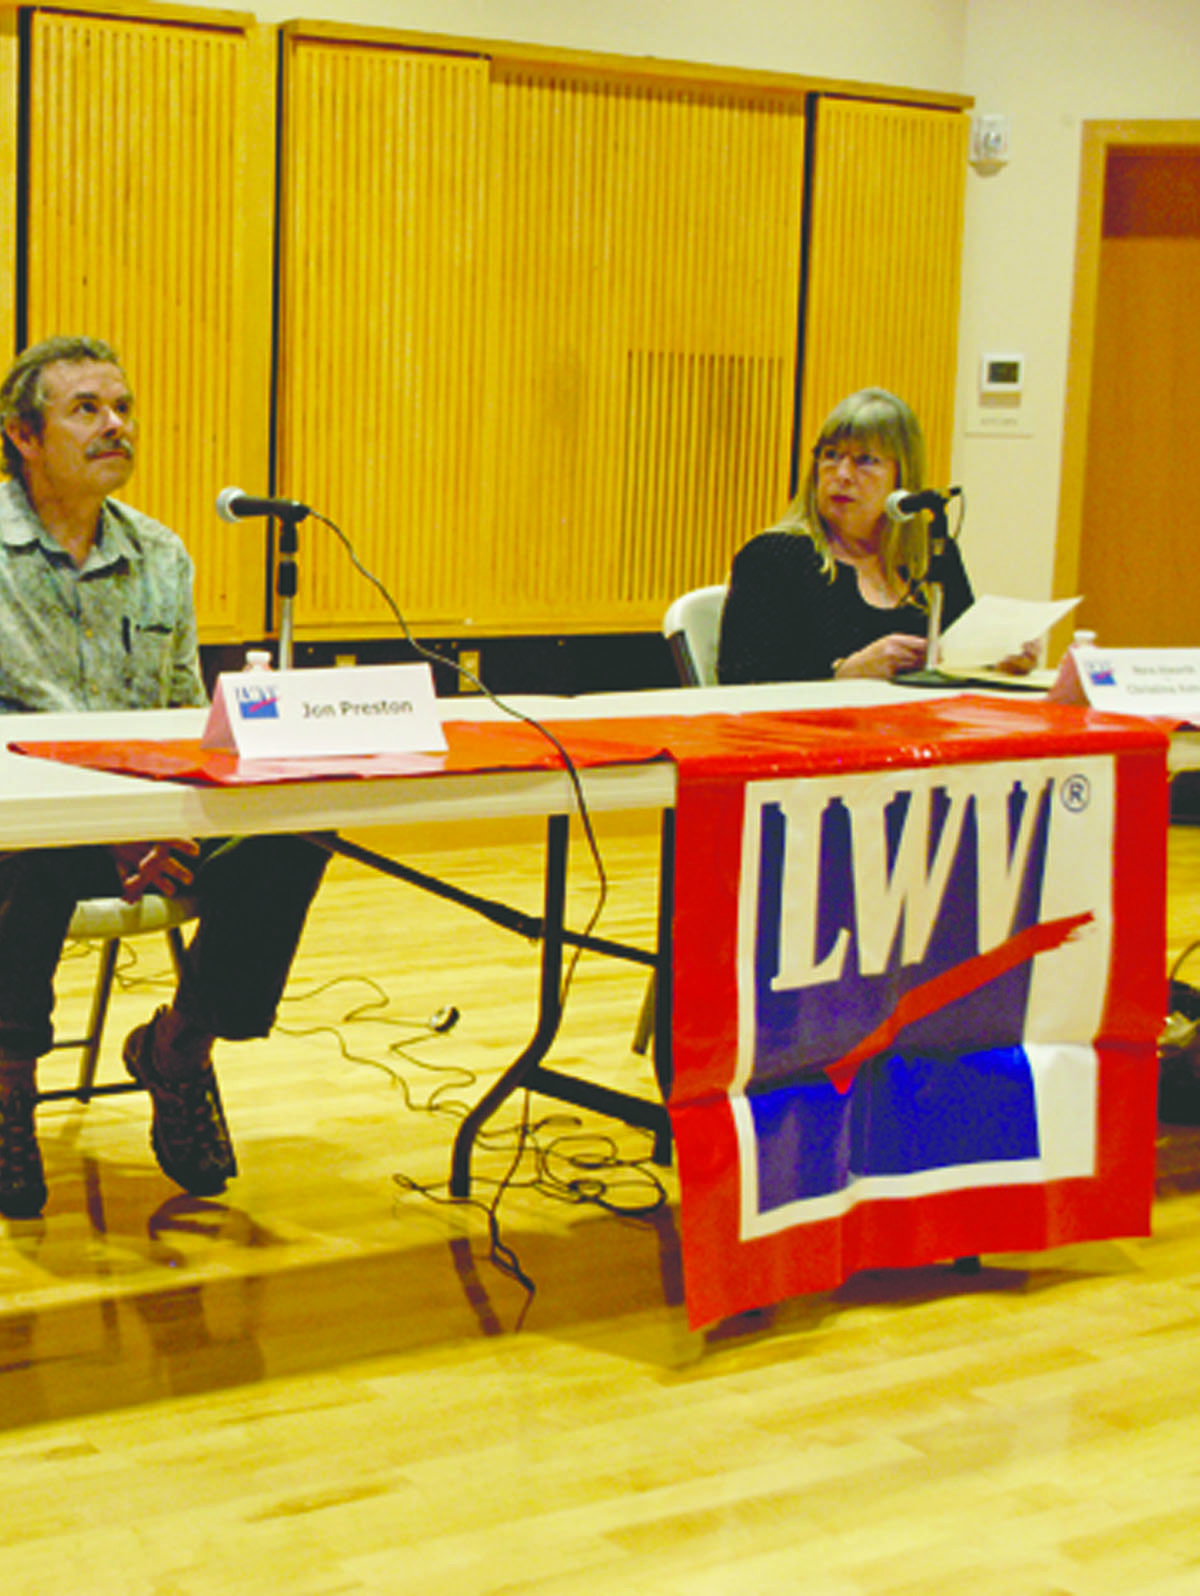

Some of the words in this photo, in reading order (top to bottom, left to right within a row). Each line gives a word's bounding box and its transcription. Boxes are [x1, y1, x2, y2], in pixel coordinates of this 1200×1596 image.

[302, 703, 335, 718] Jon
[339, 700, 413, 717] Preston
[762, 776, 1054, 992] LWV
